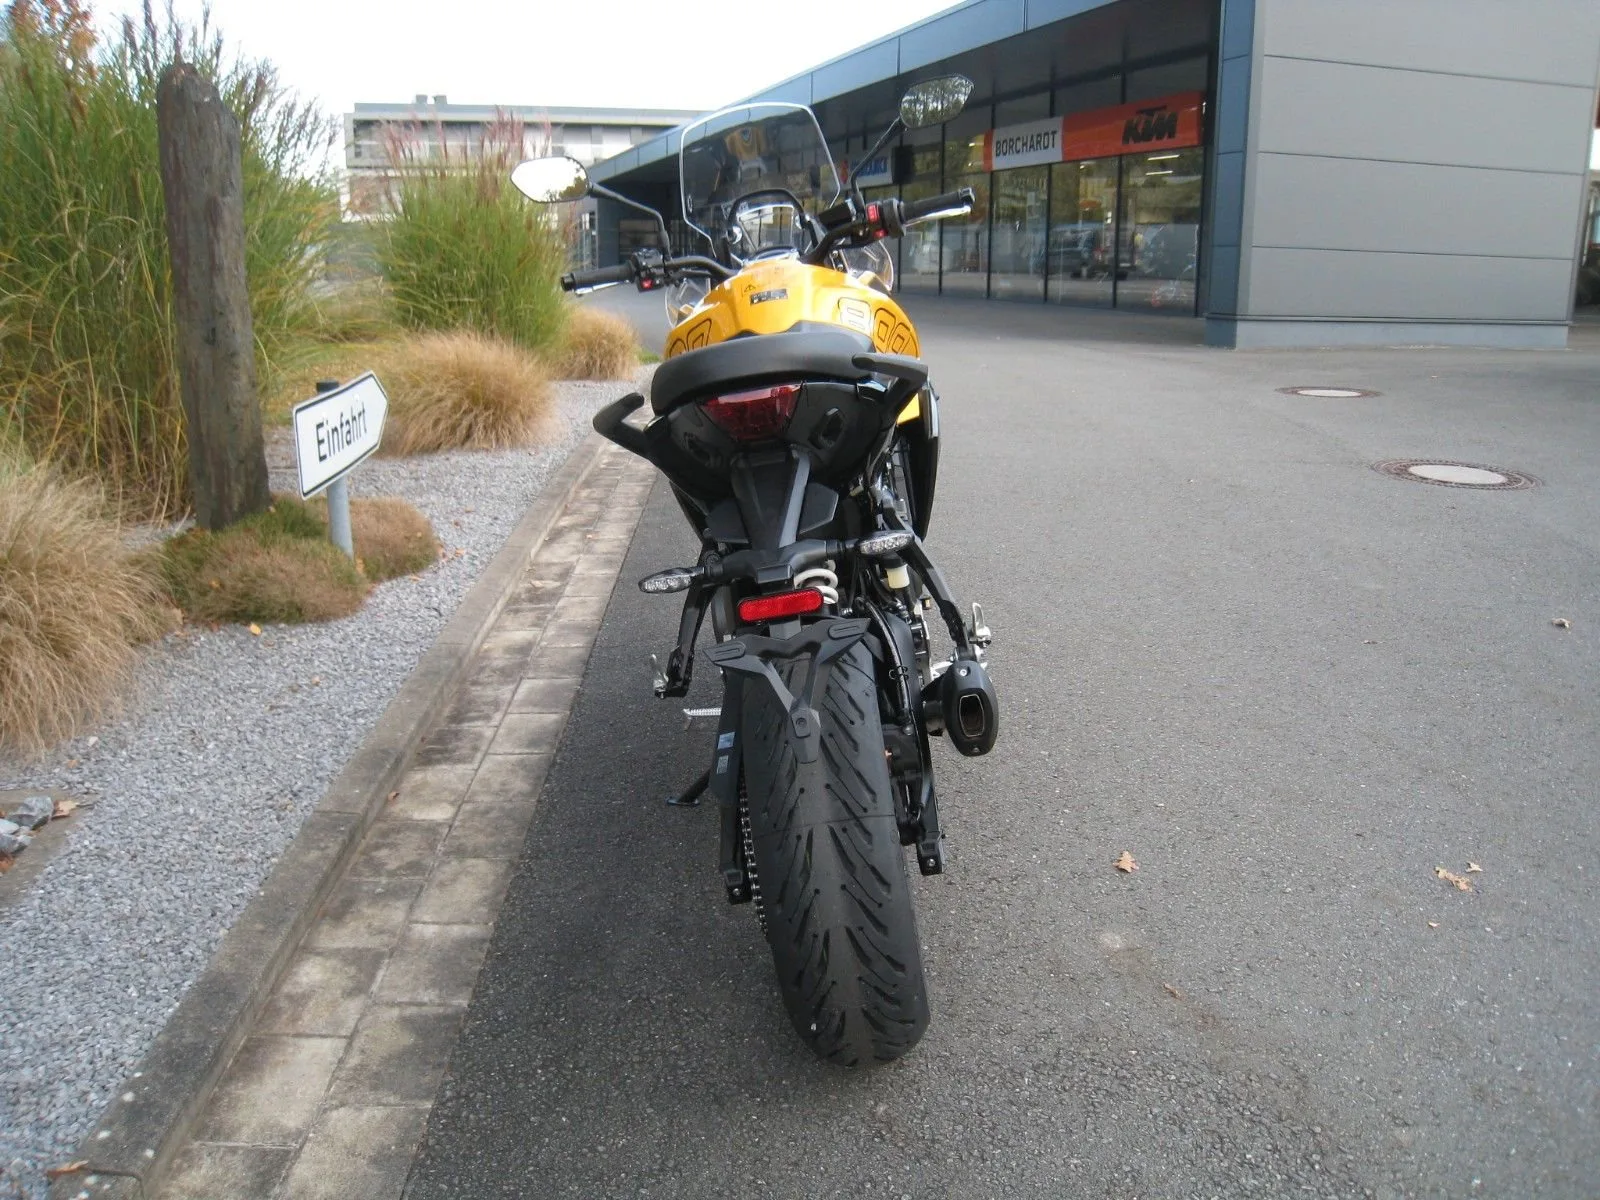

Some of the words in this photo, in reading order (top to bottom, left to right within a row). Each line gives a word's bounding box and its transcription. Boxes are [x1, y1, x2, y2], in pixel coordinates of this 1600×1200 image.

[1121, 105, 1178, 145] KTM
[995, 130, 1058, 157] BORCHARDT
[850, 156, 888, 178] ZUKI
[315, 401, 368, 463] Einfahrt
